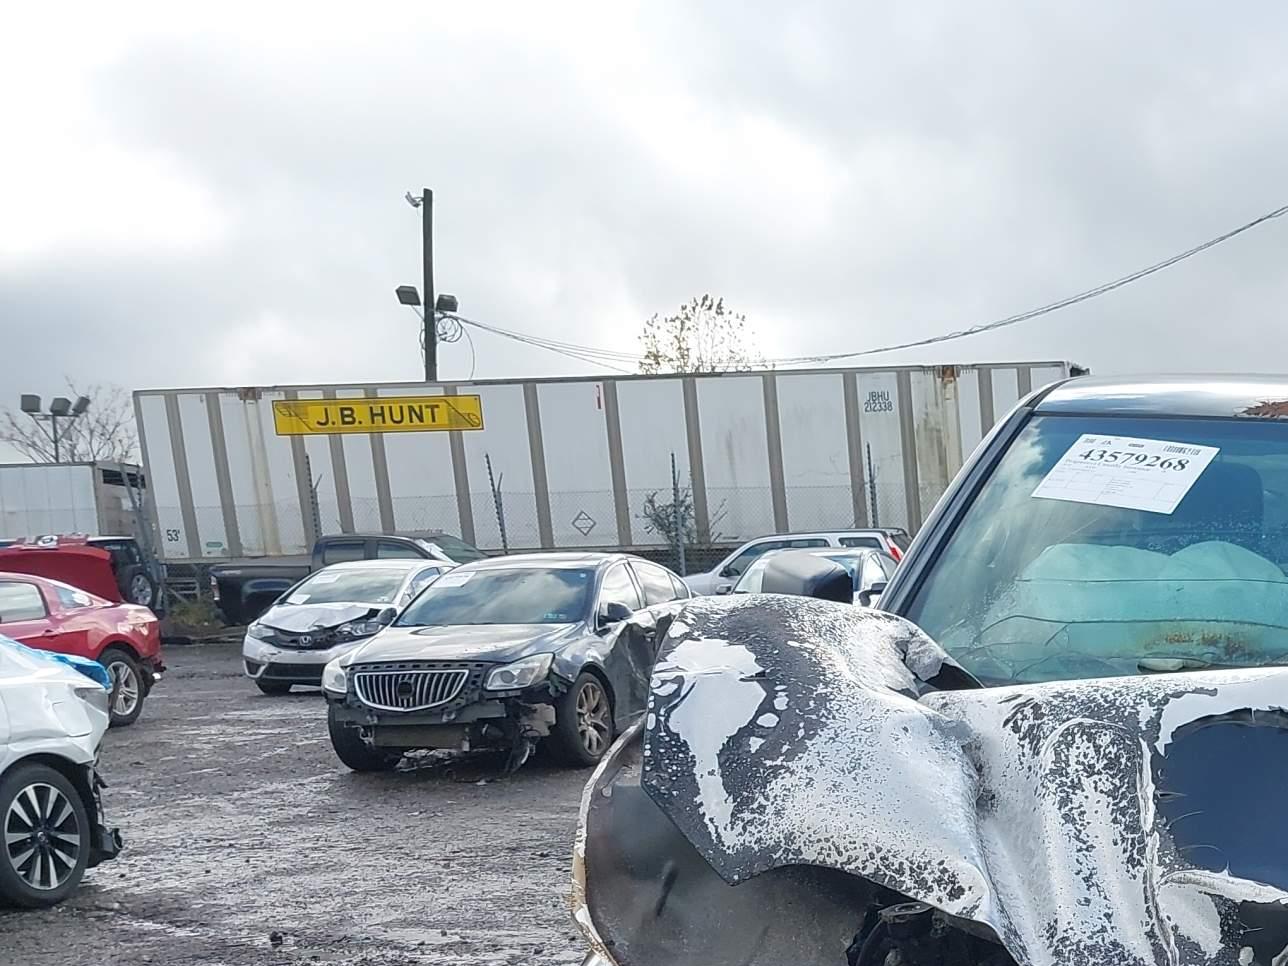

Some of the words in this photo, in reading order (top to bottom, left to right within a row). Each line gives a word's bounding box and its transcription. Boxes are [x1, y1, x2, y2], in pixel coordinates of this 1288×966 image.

[867, 390, 890, 402] JBHU
[864, 400, 893, 413] 212338
[316, 406, 363, 427] J.B.
[369, 404, 441, 425] HUNT
[1078, 448, 1191, 472] 43579268
[166, 528, 181, 542] 53'
